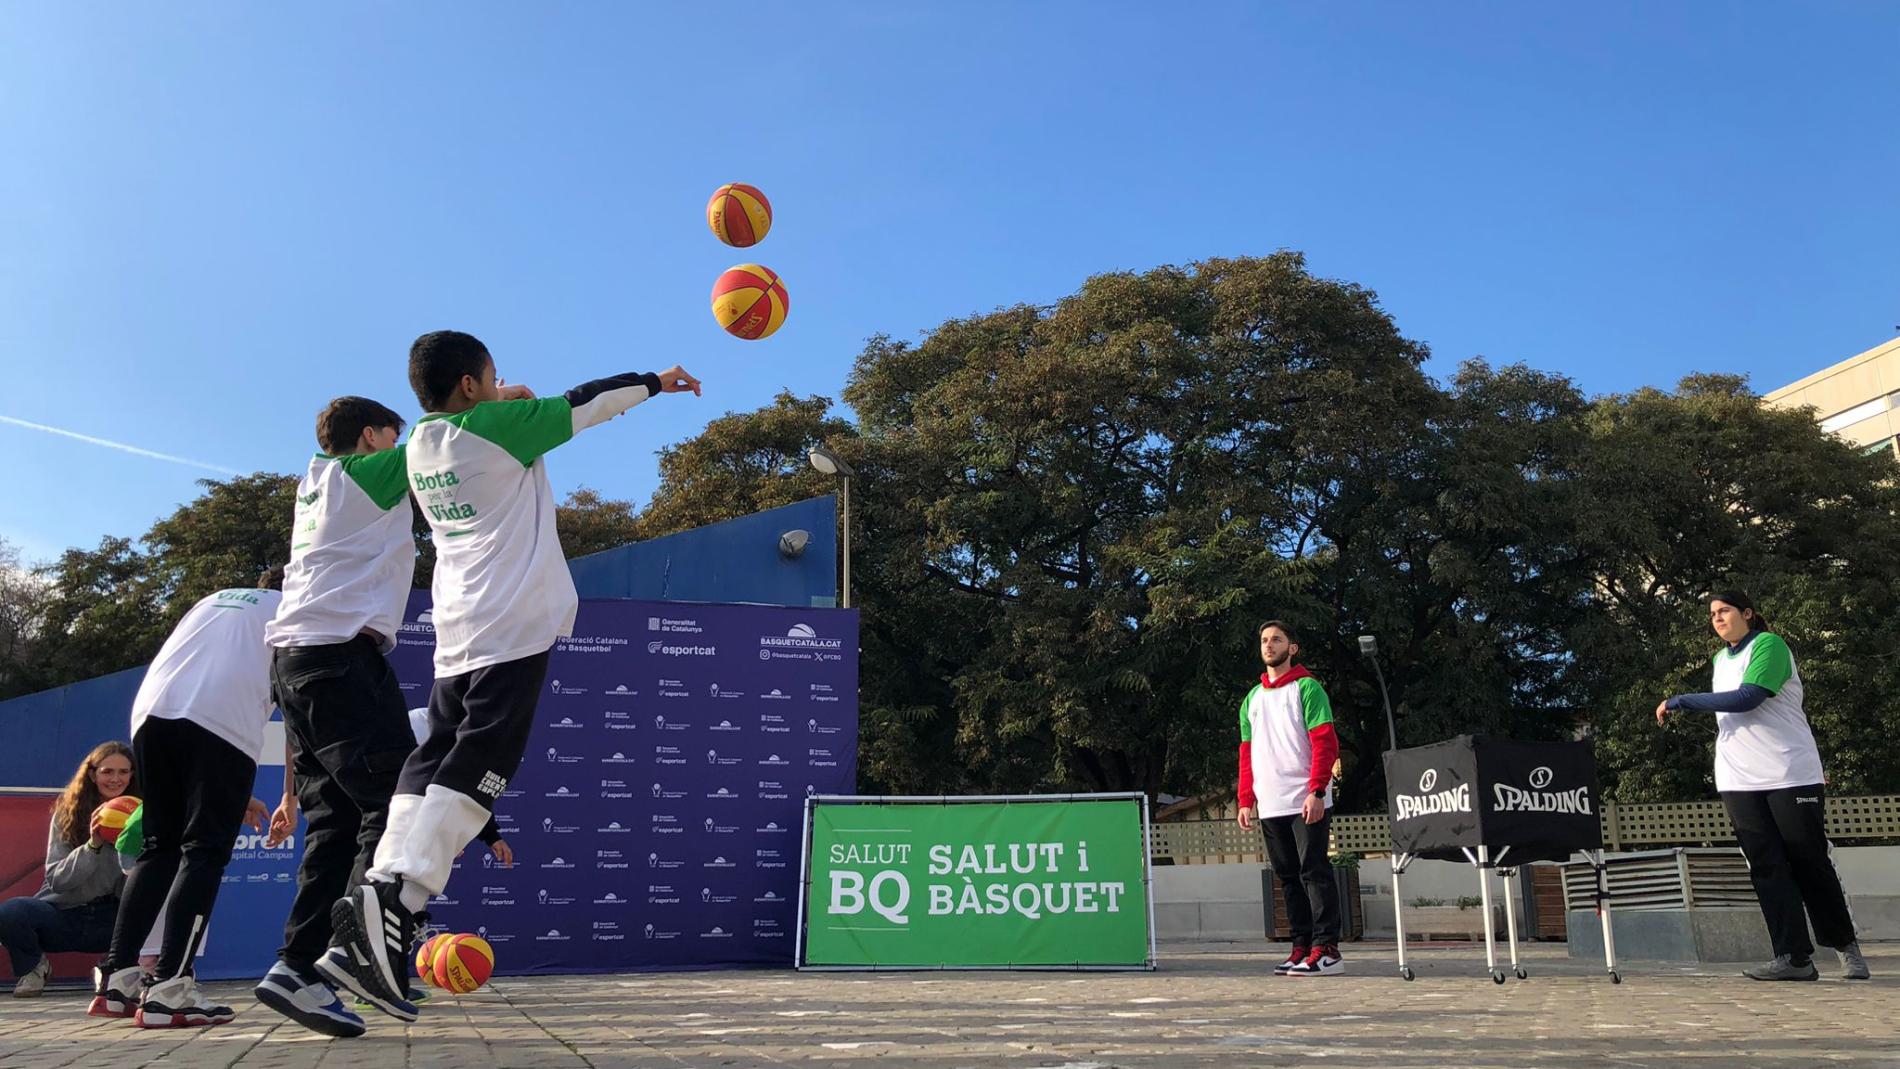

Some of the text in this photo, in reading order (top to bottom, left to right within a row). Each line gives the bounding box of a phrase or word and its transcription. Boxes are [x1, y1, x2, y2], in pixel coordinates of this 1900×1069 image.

[413, 470, 459, 491] Bota
[428, 502, 477, 522] Vida
[218, 592, 259, 605] Vida
[661, 618, 696, 626] Generalitat
[671, 625, 703, 634] Catalunya
[557, 644, 612, 653] de Basquetbol
[595, 636, 628, 645] Catalana
[760, 638, 842, 648] BASQUETCATALA.CAT
[662, 645, 716, 657] esportcat
[1396, 783, 1471, 821] SPALDING
[1494, 783, 1592, 815] SPALDING
[257, 851, 294, 860] Campus
[830, 844, 911, 864] SALUT
[929, 841, 1089, 875] SALUT i
[827, 870, 911, 925] BQ
[928, 876, 1125, 920] BÀSQUET
